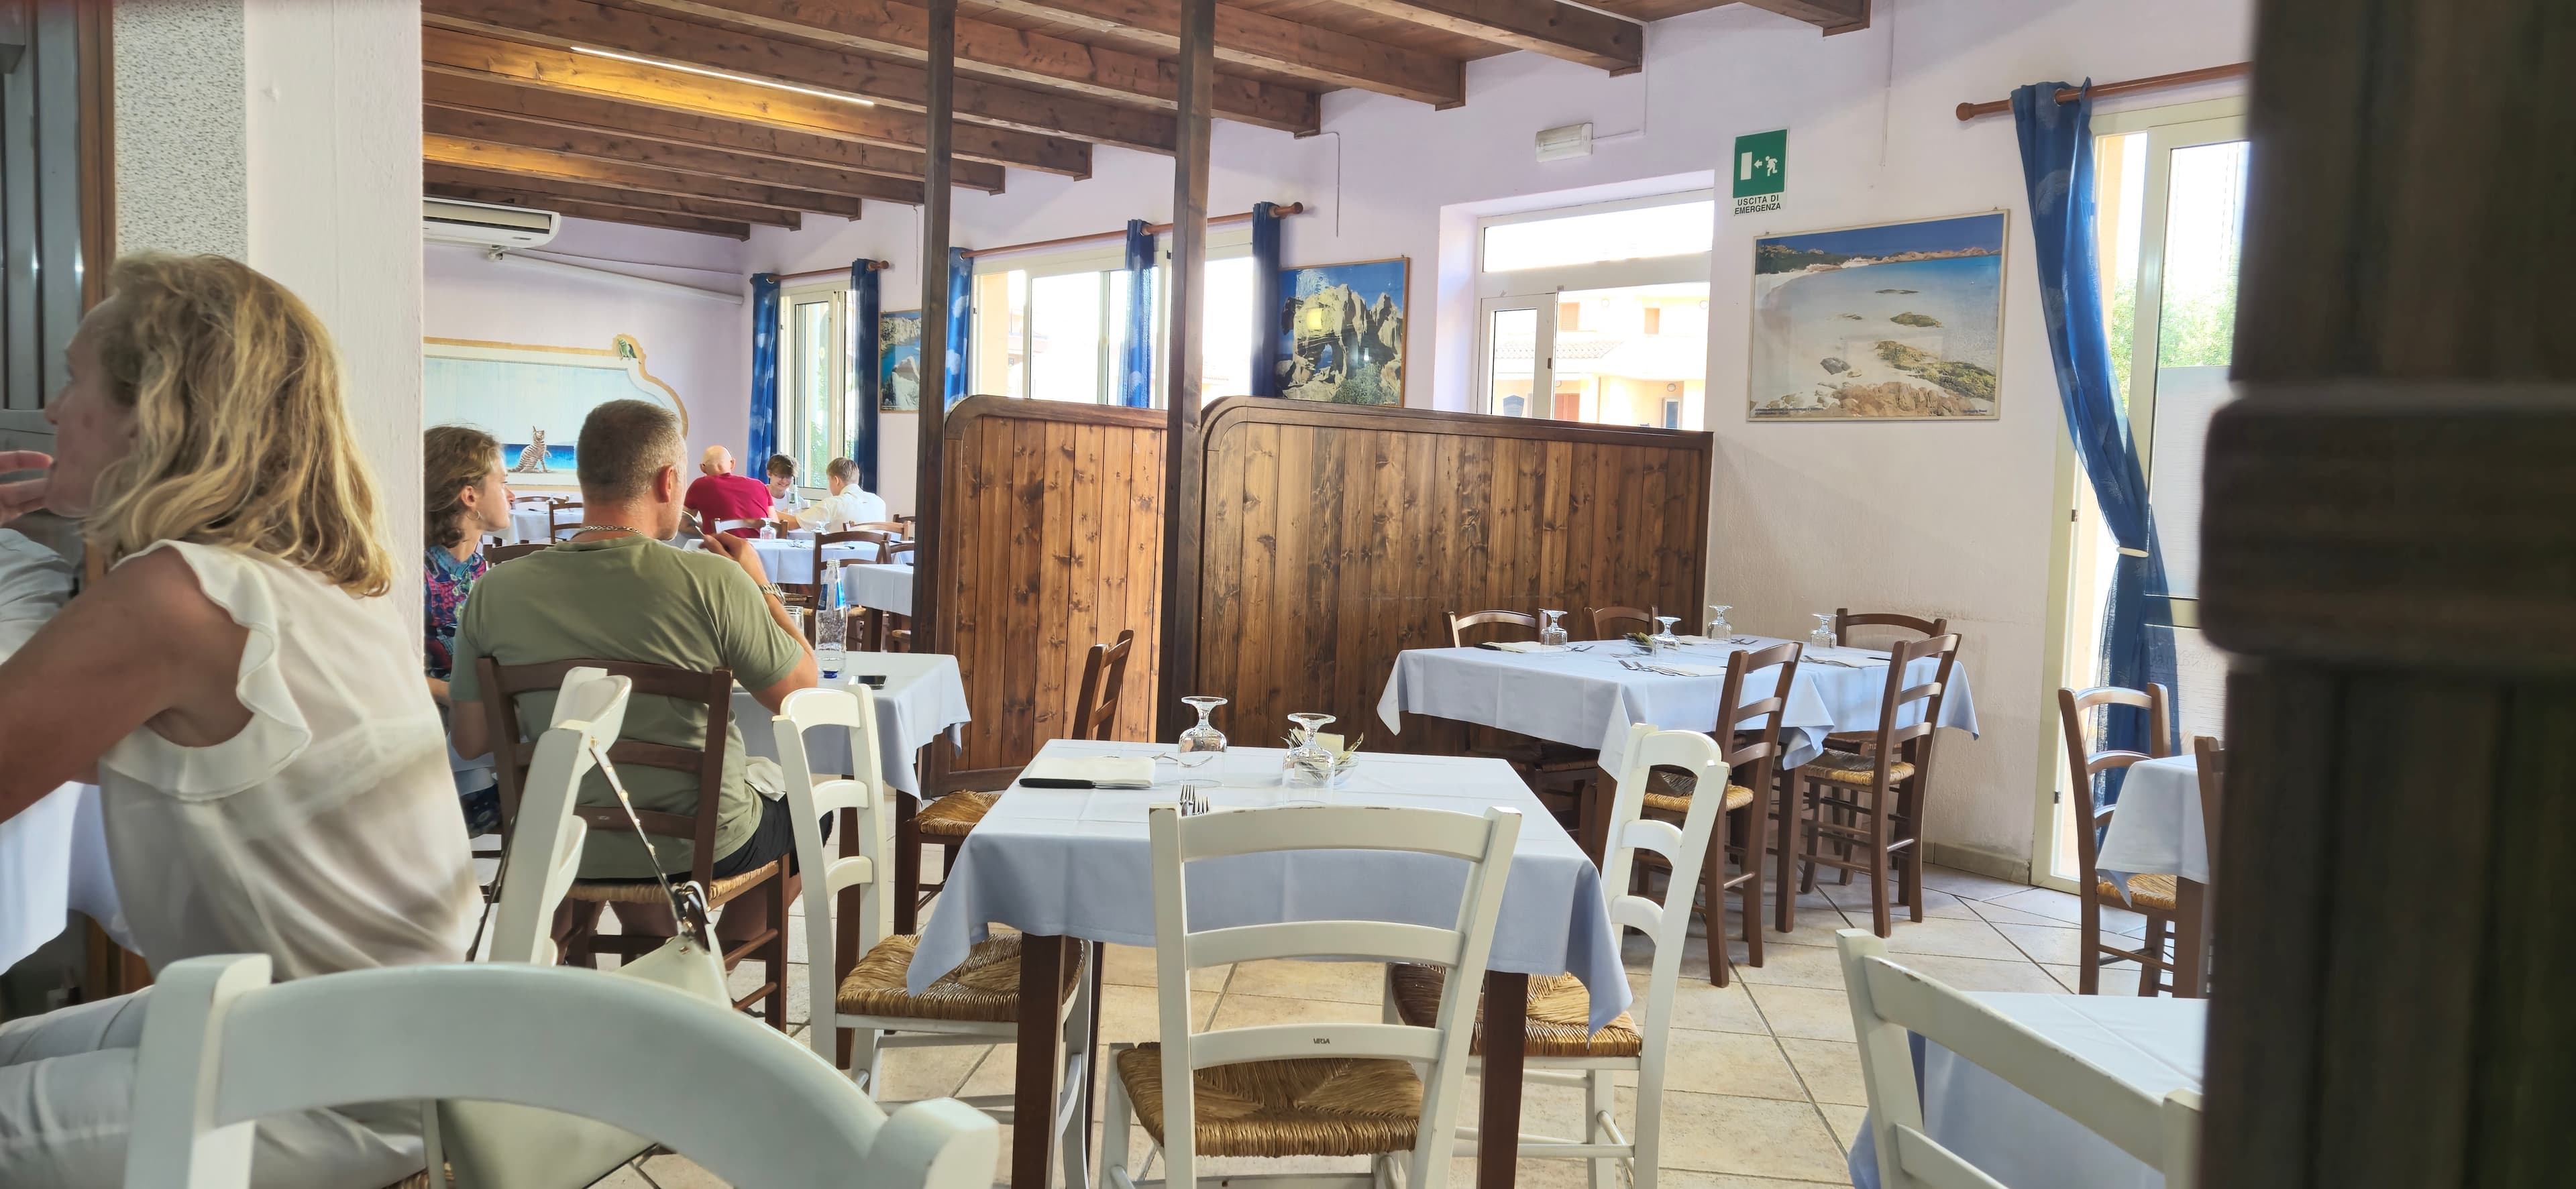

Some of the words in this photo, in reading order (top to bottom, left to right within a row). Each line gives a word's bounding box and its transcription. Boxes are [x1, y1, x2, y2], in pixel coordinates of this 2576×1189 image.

[1737, 196, 1767, 206] USCITA
[1770, 194, 1779, 202] DI
[1735, 203, 1781, 215] EMERGENZA
